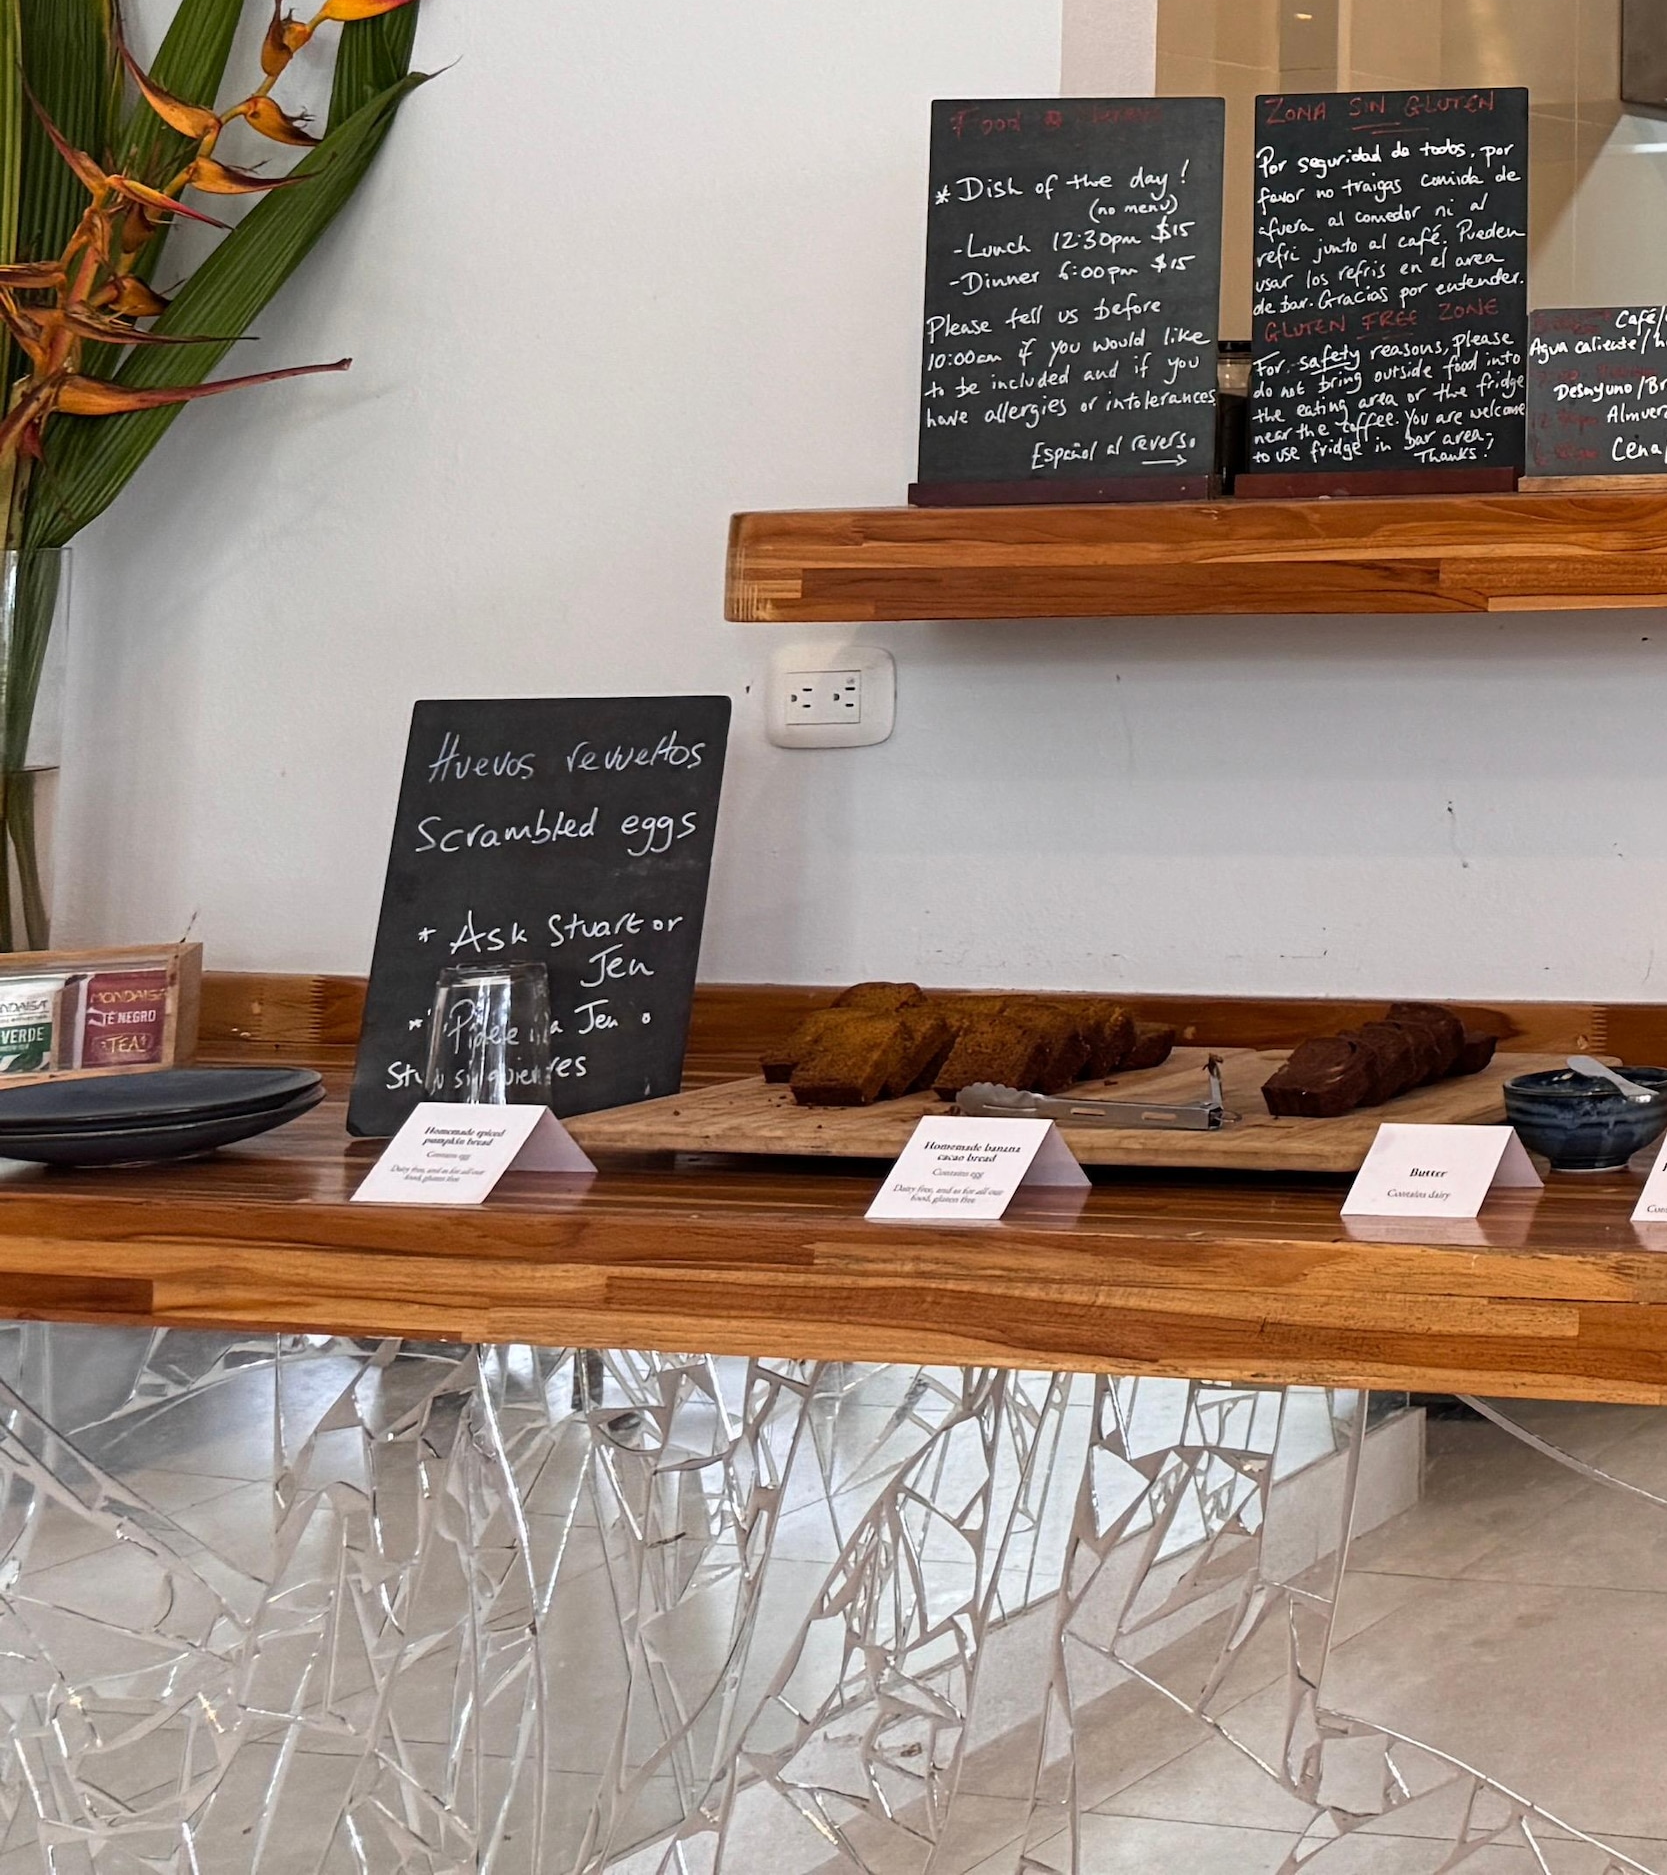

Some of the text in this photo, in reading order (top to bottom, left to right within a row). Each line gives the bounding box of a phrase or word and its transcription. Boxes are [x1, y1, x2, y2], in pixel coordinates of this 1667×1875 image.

[1264, 91, 1494, 124] ZONA SIN GLUTEN
[1256, 146, 1287, 178] Por
[1298, 144, 1382, 178] seguridad
[1391, 141, 1410, 158] de
[1480, 144, 1514, 168] por
[956, 177, 1023, 201] Dish
[1035, 174, 1058, 200] of
[1066, 174, 1112, 189] the
[1257, 187, 1305, 215] favor
[1316, 189, 1334, 198] no
[1342, 172, 1402, 203] traigas
[1495, 165, 1521, 182] de
[1151, 215, 1195, 243] $15
[1151, 253, 1195, 273] $15
[1313, 237, 1357, 264] junto
[926, 293, 1160, 343] Please tell us before
[1264, 297, 1499, 342] GLUTEN FREE ZONE
[1019, 338, 1036, 366] if
[1048, 340, 1080, 367] you
[1093, 328, 1145, 352] would
[1164, 327, 1211, 345] like
[1299, 345, 1360, 371] safety
[1453, 330, 1514, 355] please
[1529, 337, 1568, 364] Agua
[925, 352, 1199, 398] to be included and if you
[927, 408, 968, 427] have
[985, 399, 1066, 428] allergies
[1081, 396, 1097, 412] or
[1032, 441, 1097, 469] Español
[429, 732, 535, 782] Huevos
[416, 807, 696, 856] Scrambled eggs
[450, 910, 683, 954] Ask Stuart or
[580, 944, 654, 987] Jen
[117, 1010, 156, 1024] NEGRO
[574, 999, 618, 1034] Jen
[1, 1027, 45, 1044] VERDE
[1409, 1168, 1448, 1178] Butter
